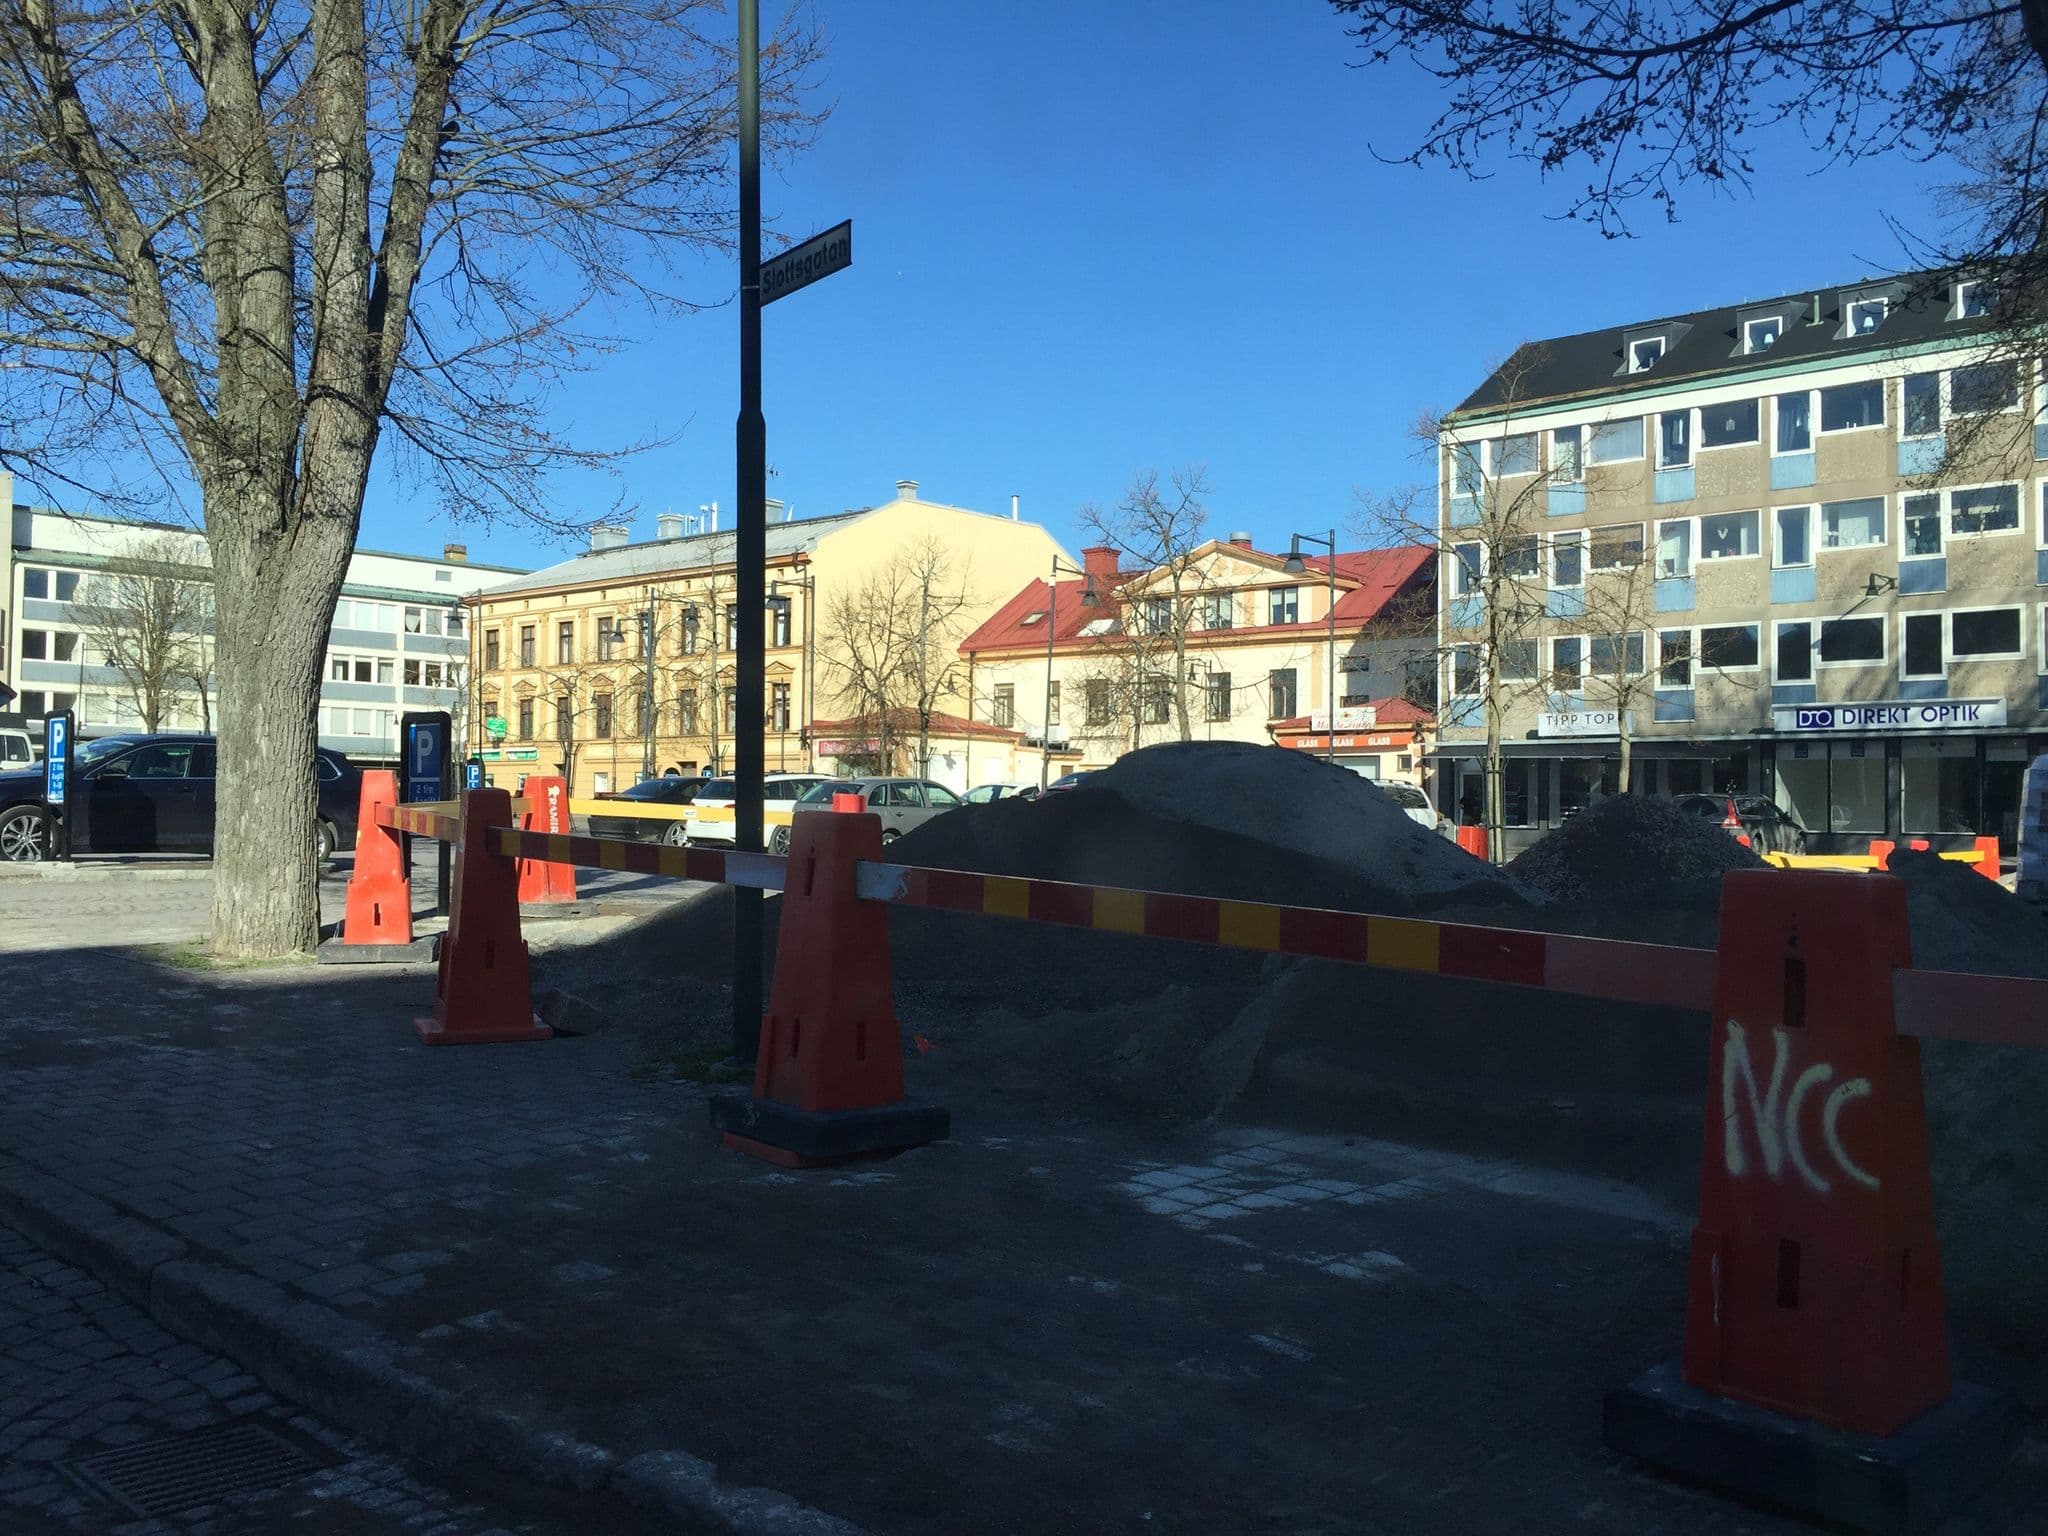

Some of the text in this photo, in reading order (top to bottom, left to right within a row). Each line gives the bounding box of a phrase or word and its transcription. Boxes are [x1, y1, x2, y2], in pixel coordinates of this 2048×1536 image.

[762, 237, 849, 295] Slottsgatan
[1546, 713, 1615, 725] TIPP TOP
[1842, 707, 1911, 725] DIREKT
[1920, 704, 1981, 722] OPTIK
[53, 722, 64, 756] P
[417, 730, 434, 774] P
[1297, 737, 1391, 748] GLASS GLASS GLASS
[471, 767, 480, 780] P
[1723, 1019, 1881, 1192] NCC
